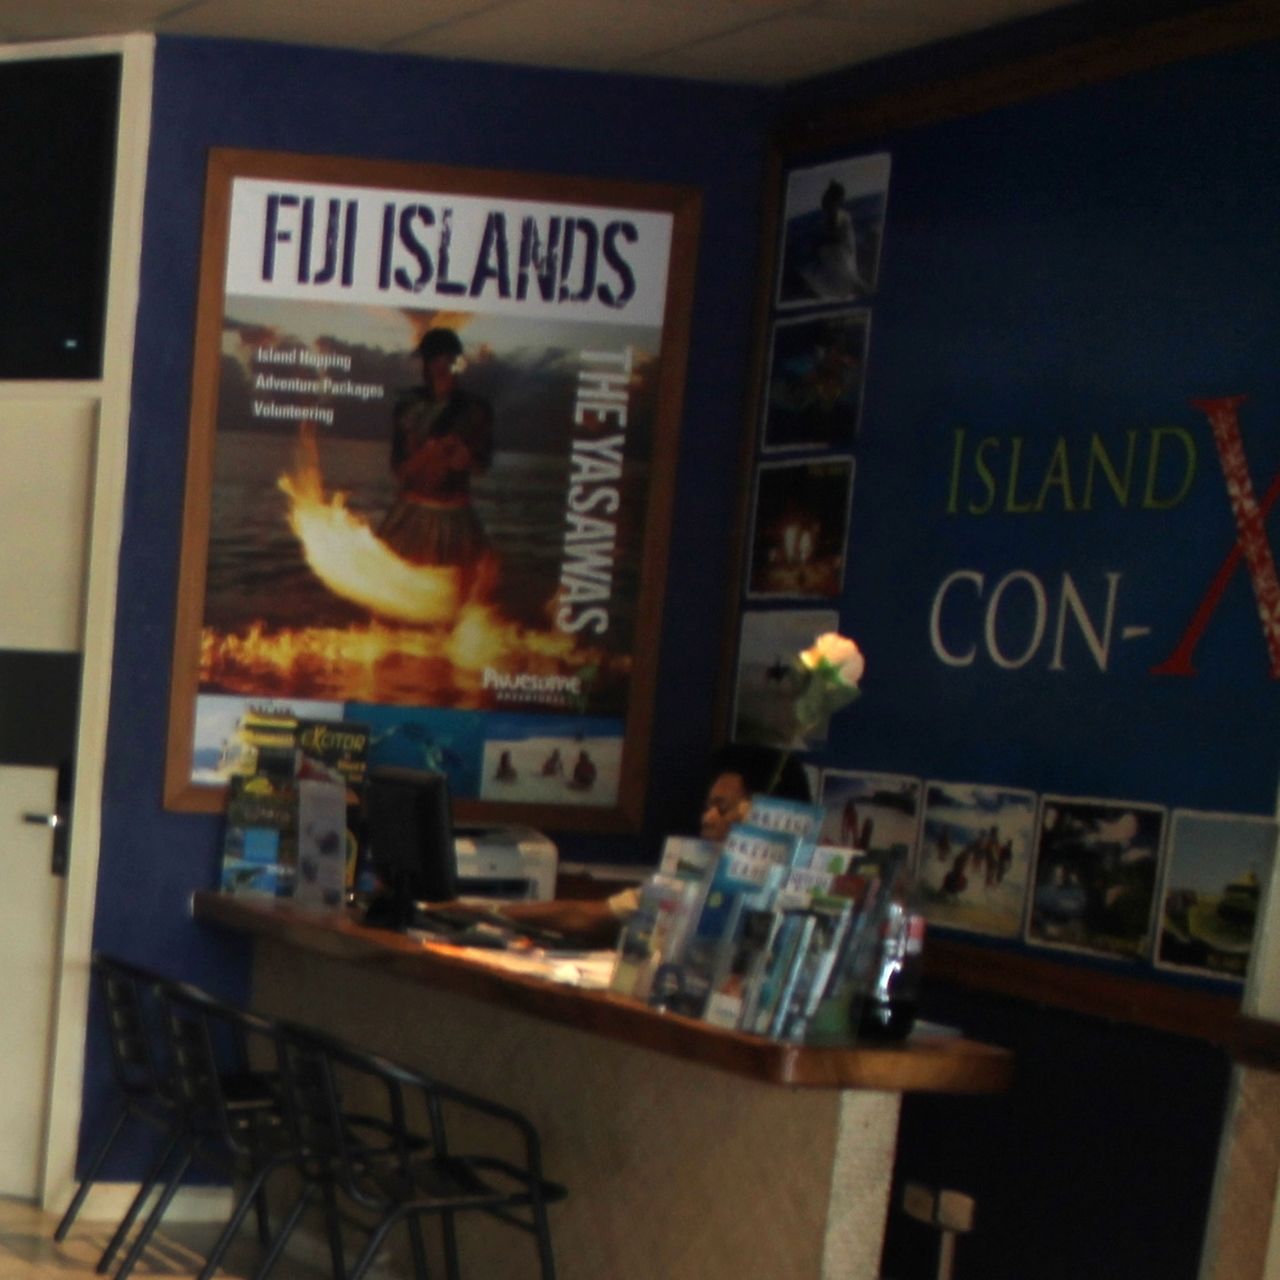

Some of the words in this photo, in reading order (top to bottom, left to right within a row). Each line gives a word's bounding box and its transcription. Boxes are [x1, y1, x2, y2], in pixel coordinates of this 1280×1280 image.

[261, 193, 359, 287] FIJI
[378, 203, 639, 310] ISLANDS
[255, 372, 320, 393] Adventure
[322, 376, 385, 401] Packages
[256, 346, 297, 365] Island
[299, 347, 352, 372] Hopping
[573, 346, 632, 428] THE
[253, 400, 335, 426] Volunteering
[946, 424, 1198, 516] ISLAND
[556, 438, 625, 636] YASAWAS
